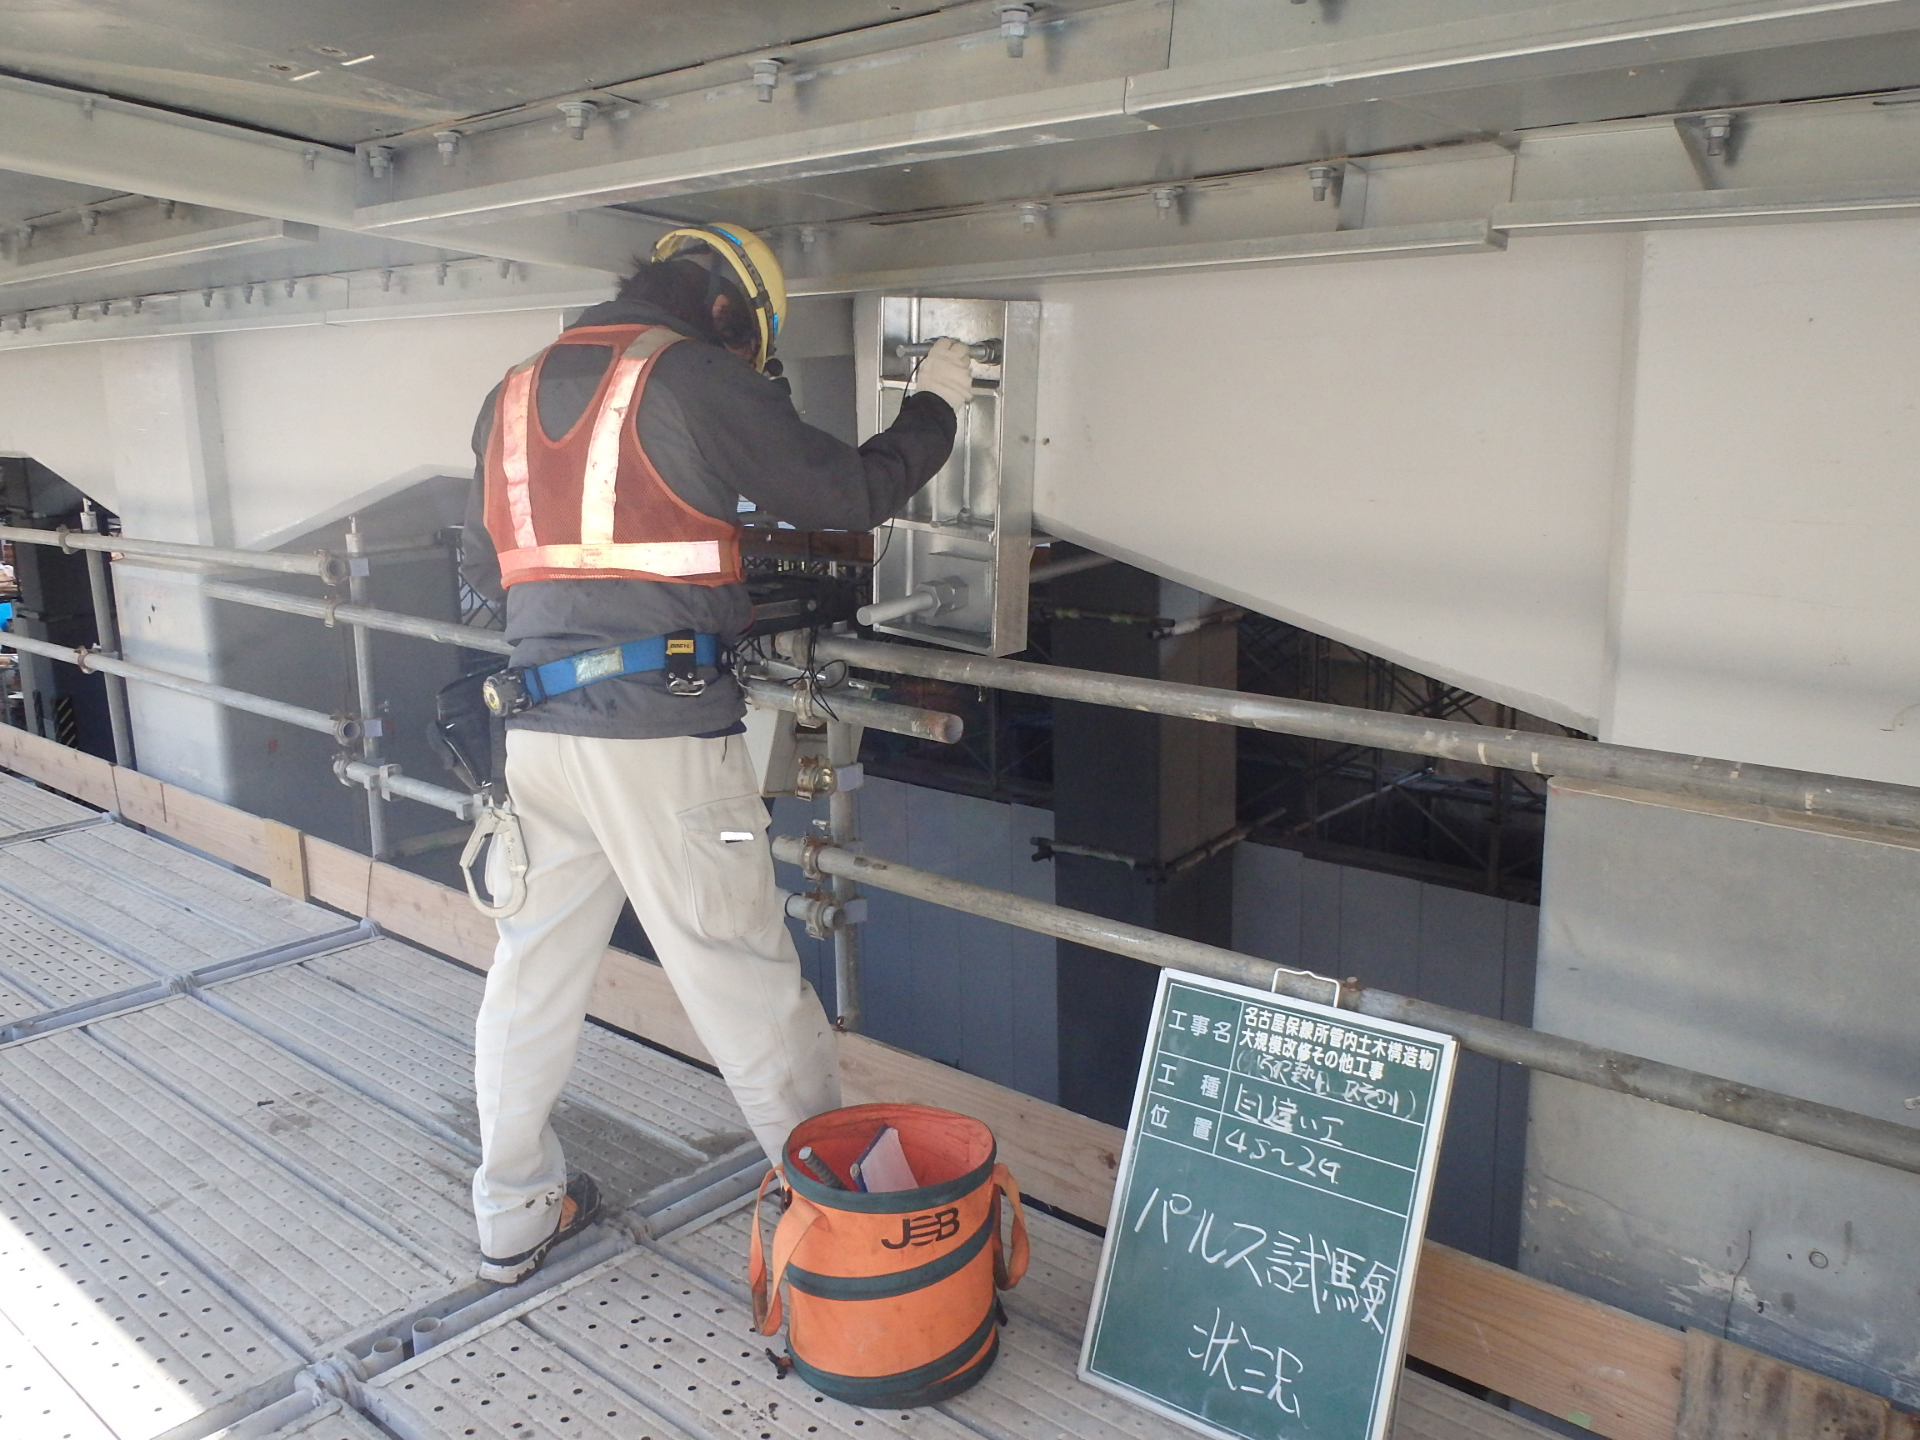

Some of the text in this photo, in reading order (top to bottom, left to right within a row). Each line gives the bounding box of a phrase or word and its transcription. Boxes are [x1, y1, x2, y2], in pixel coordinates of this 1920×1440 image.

[1167, 1009, 1233, 1043] 工事名
[1243, 1006, 1435, 1071] 名古屋保線所管内土木構造物
[1157, 1063, 1221, 1098] 工種
[1239, 1028, 1384, 1081] 大規模改修その他工事
[1150, 1104, 1213, 1141] 位置
[1134, 1187, 1398, 1334] パルス試験
[1187, 1307, 1304, 1418] 状況
